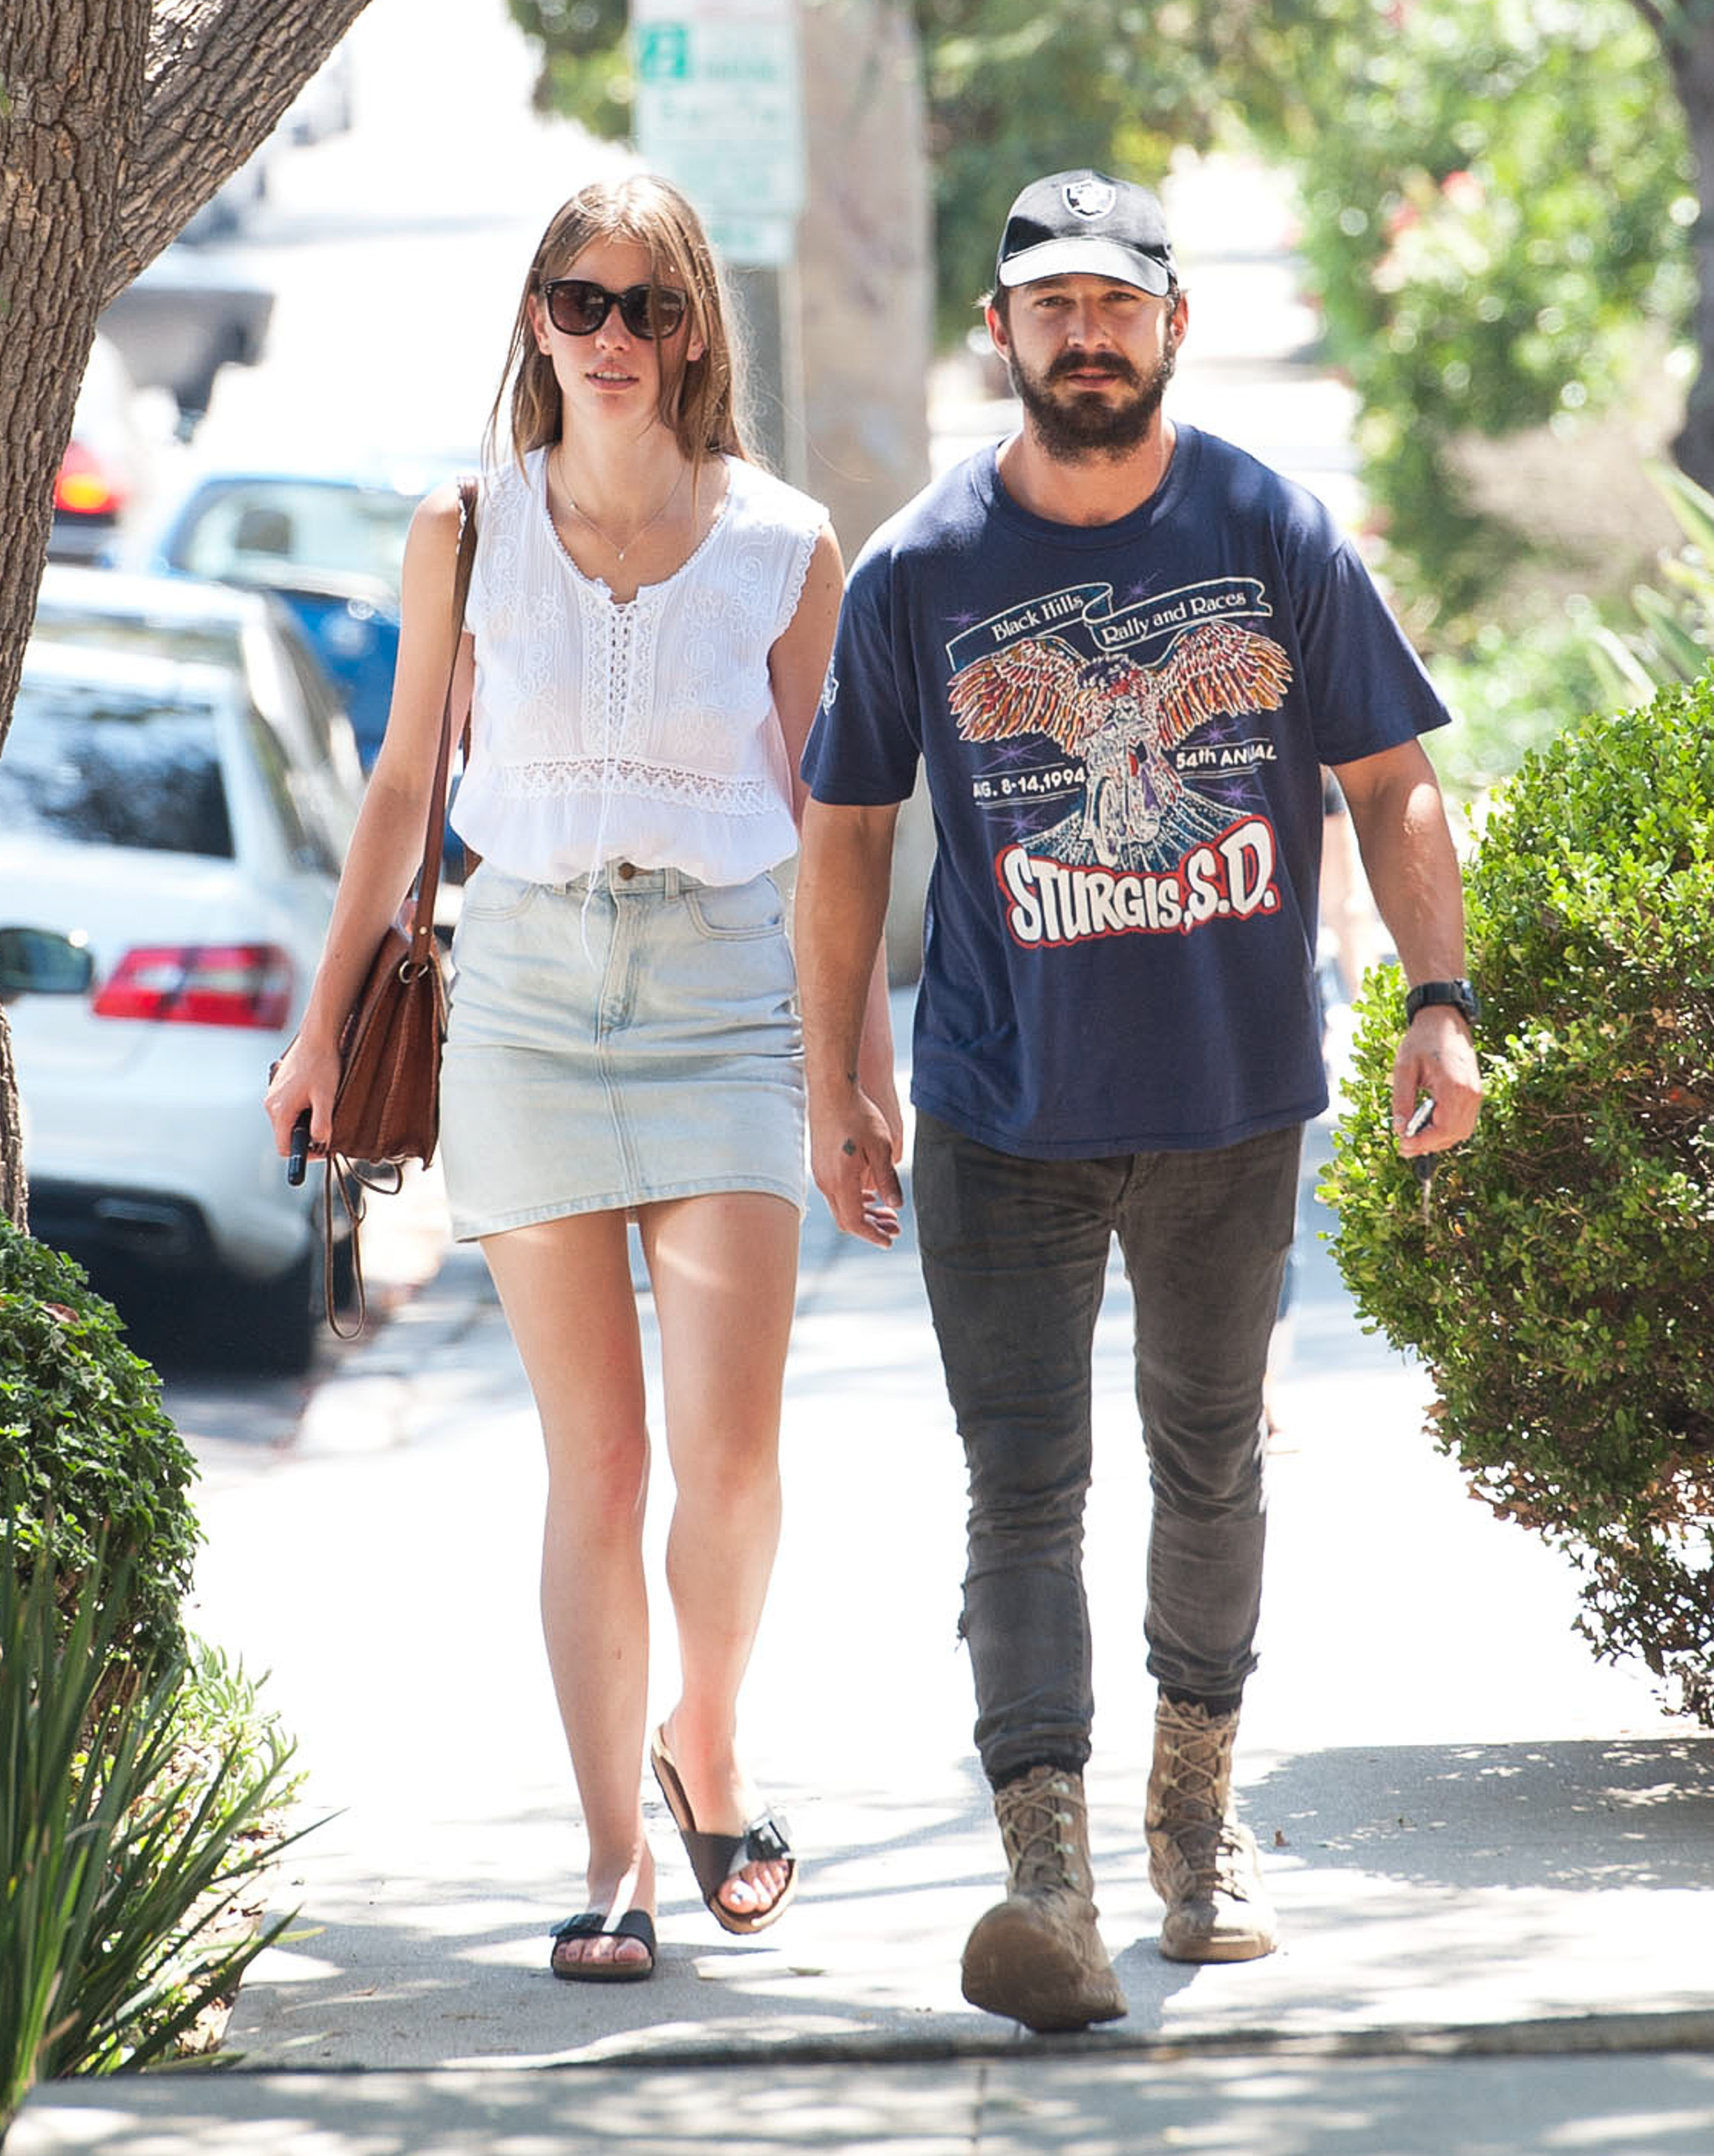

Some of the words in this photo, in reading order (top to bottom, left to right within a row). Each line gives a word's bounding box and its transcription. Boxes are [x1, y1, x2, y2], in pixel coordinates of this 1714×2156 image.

[991, 609, 1041, 642] Black
[1041, 594, 1084, 620] Hills
[1100, 617, 1148, 645] Rally
[1153, 602, 1187, 626] and
[1190, 592, 1247, 615] Races
[1176, 748, 1216, 770] 54th
